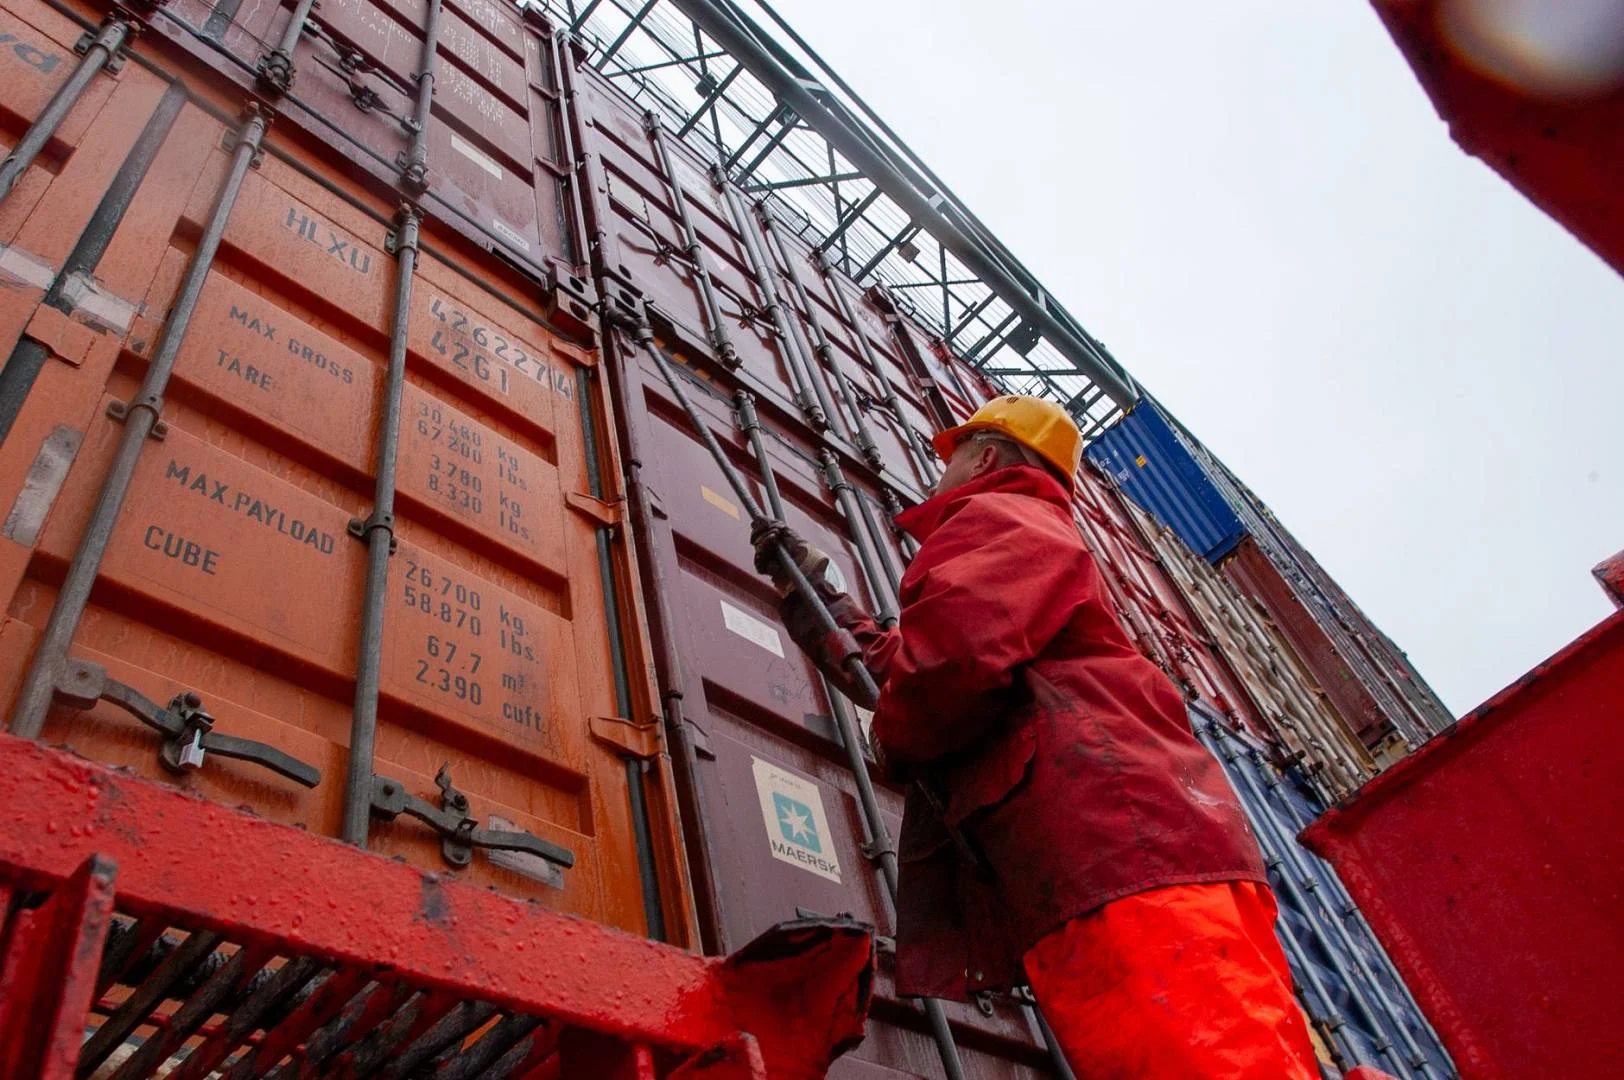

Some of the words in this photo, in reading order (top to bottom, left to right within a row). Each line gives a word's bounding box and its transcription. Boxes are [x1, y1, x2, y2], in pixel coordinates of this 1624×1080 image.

[286, 207, 370, 274] HLXU
[217, 349, 274, 392] TARE
[288, 339, 354, 385] GROSS
[431, 330, 510, 393] 42G1
[428, 473, 482, 514] 8.330
[430, 454, 482, 493] 3.780
[144, 524, 221, 576] CUBE
[405, 560, 482, 611] 26.700
[404, 584, 482, 637] 58.870
[501, 629, 540, 665] lbs.
[416, 659, 482, 706] 2.390
[771, 839, 837, 874] MAERSK
